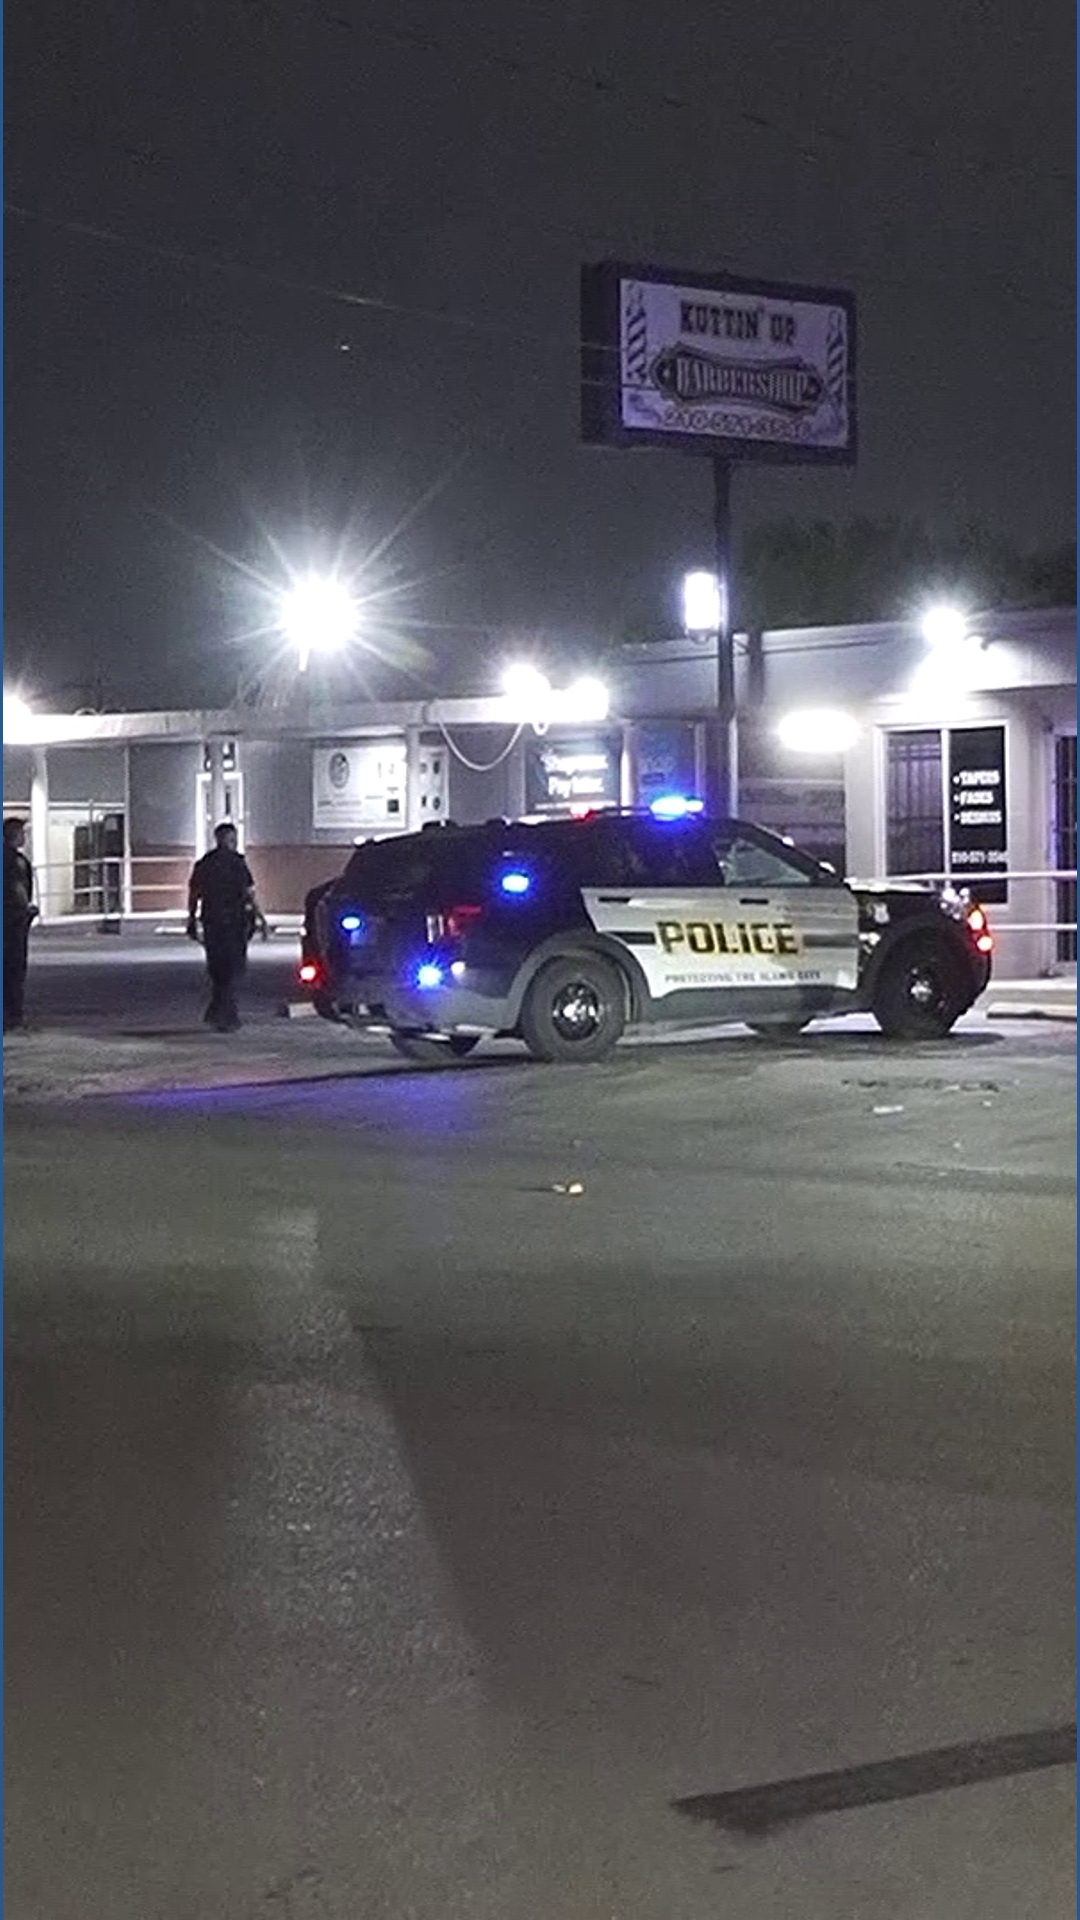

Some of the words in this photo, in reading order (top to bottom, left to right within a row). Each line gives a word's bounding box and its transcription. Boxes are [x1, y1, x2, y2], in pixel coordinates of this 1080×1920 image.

[680, 300, 766, 340] KUTTIN'
[770, 314, 796, 346] UP
[676, 358, 809, 405] BARBERSHOP
[656, 921, 799, 955] POLICE
[665, 974, 734, 984] PROTECTING
[736, 973, 755, 982] THE
[759, 972, 795, 982] ALAMO
[797, 970, 822, 980] CITY
